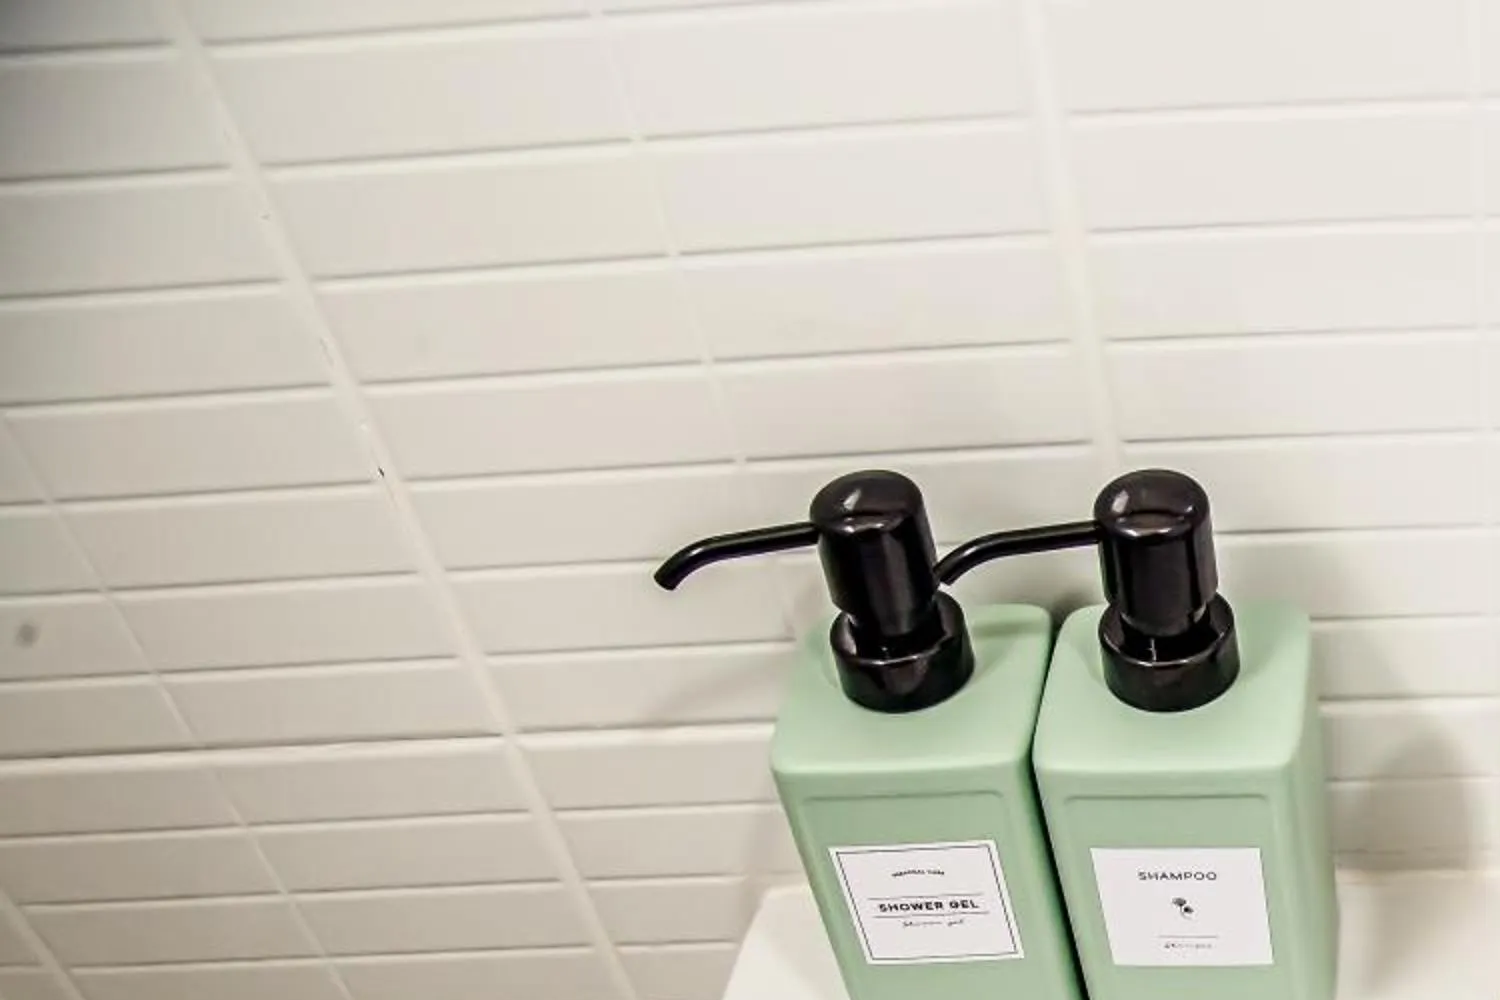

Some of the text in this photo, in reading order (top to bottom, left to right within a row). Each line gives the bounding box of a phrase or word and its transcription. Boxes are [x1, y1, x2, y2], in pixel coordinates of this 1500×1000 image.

[1137, 870, 1218, 881] SHAMPOO
[879, 899, 980, 913] SHOWER GEL
